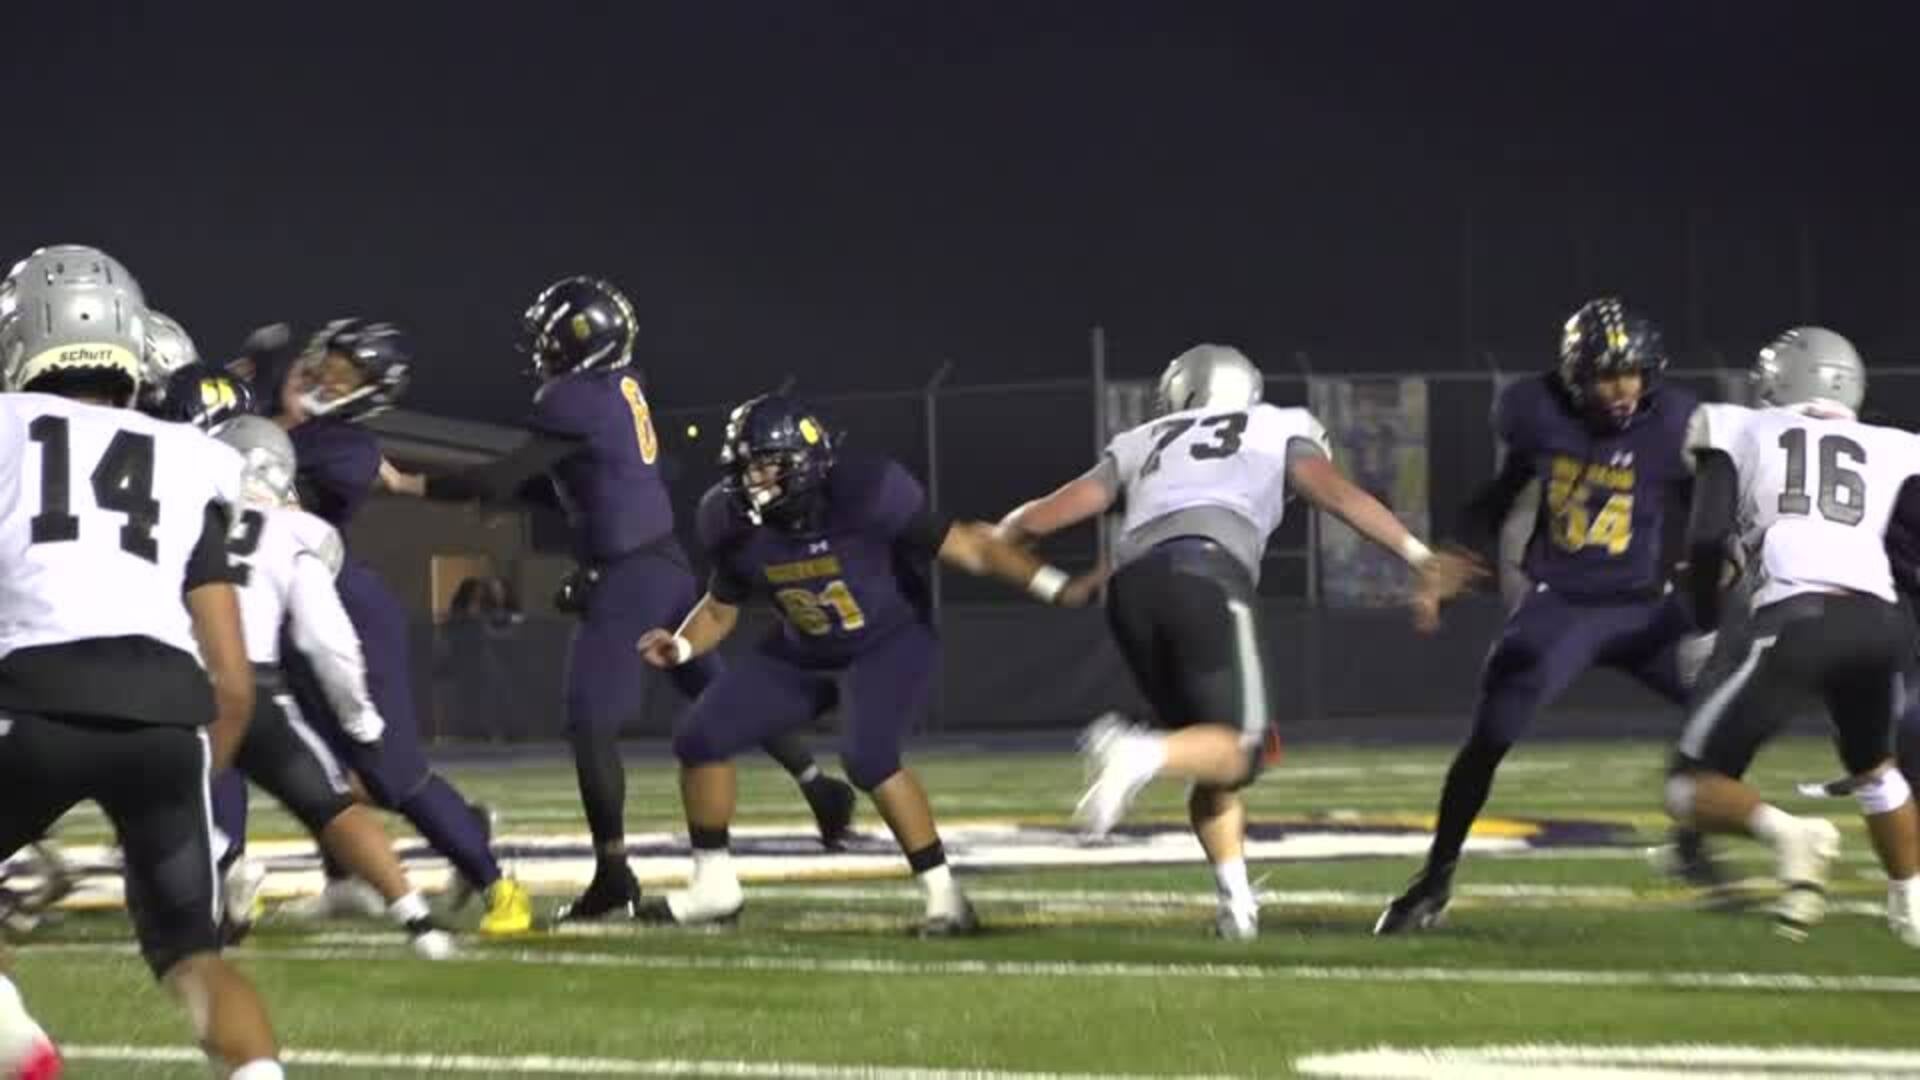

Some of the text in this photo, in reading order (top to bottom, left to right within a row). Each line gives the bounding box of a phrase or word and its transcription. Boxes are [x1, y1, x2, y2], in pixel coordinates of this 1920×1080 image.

[29, 414, 160, 565] 14
[1140, 412, 1248, 478] 73
[1778, 427, 1867, 527] 16
